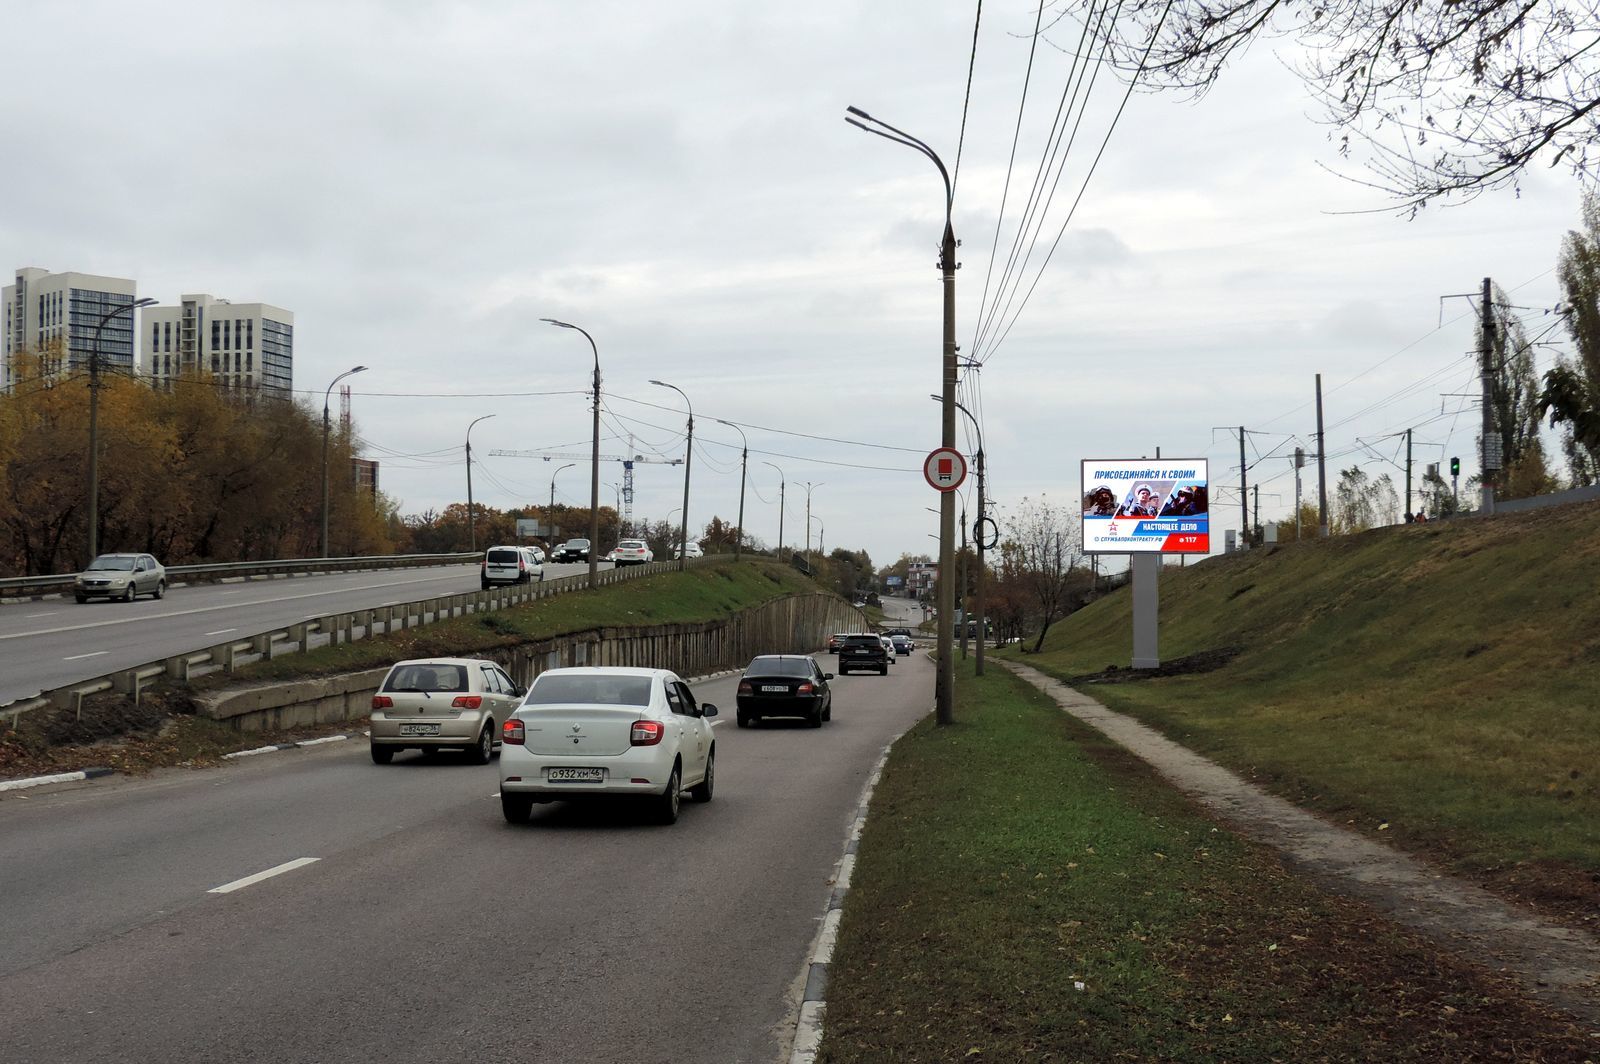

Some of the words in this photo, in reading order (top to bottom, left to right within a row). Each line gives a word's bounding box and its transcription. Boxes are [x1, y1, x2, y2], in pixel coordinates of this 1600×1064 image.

[1094, 469, 1160, 480] ПРИСОЕДИНЯЙСЯ
[1162, 470, 1167, 479] К
[1168, 470, 1196, 479] СВОИМ
[552, 770, 588, 778] О932ХМ
